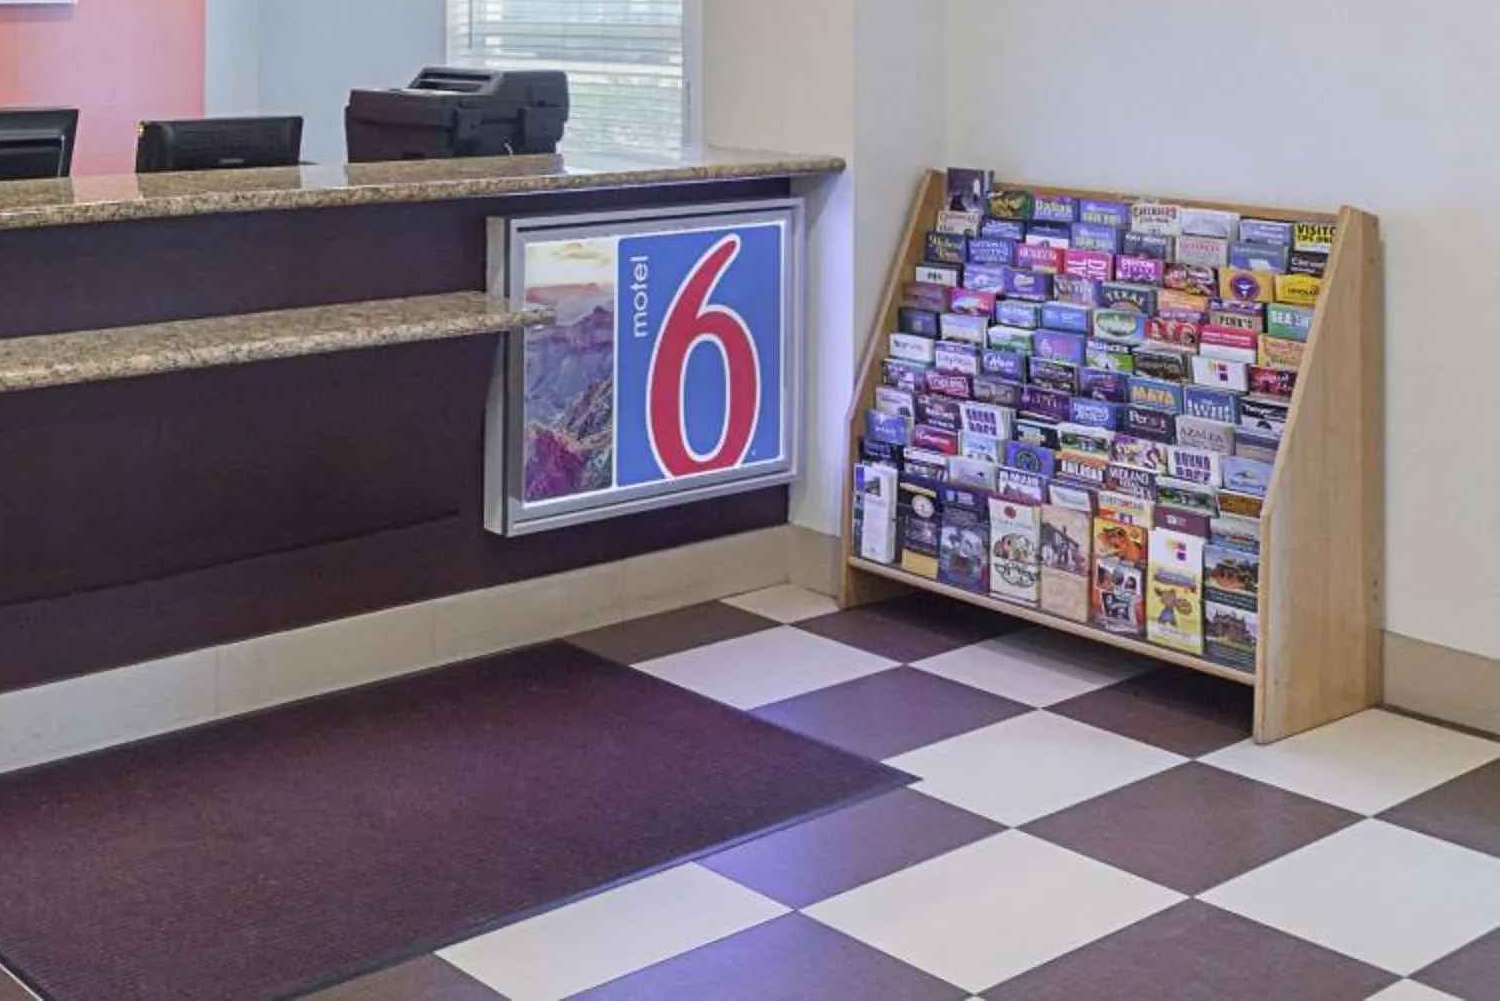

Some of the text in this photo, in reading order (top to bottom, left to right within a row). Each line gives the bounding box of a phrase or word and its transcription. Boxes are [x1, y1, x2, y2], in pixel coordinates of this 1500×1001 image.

[1297, 223, 1337, 236] VISITO
[629, 255, 649, 338] motel
[645, 233, 761, 481] 6
